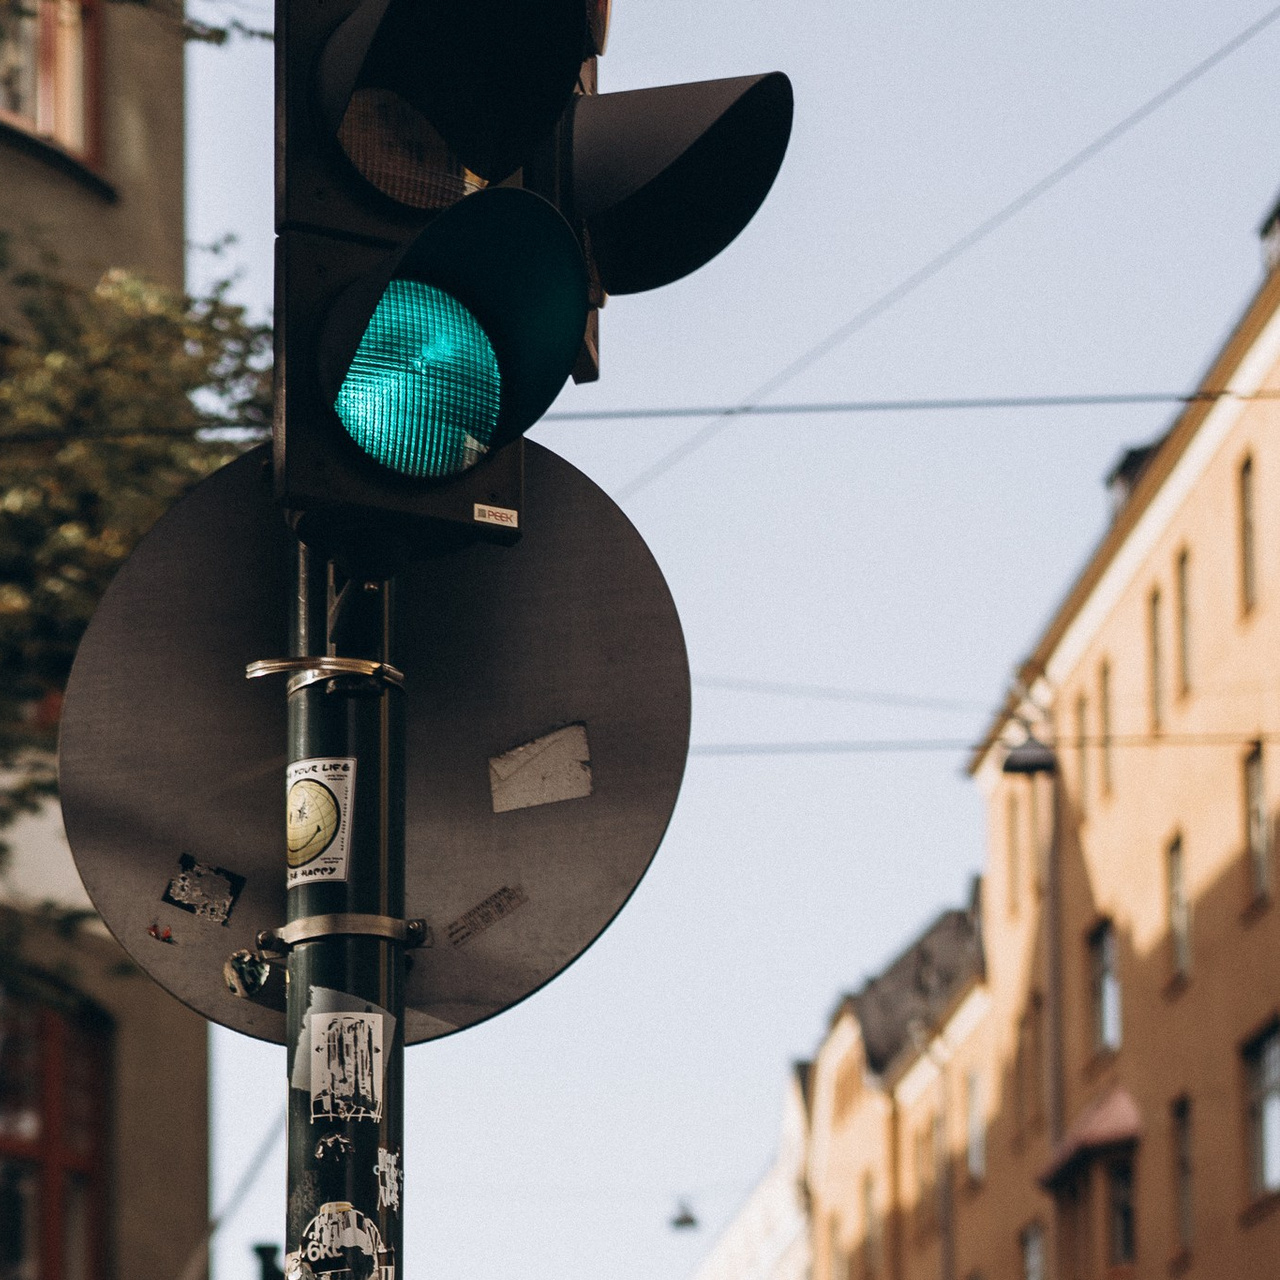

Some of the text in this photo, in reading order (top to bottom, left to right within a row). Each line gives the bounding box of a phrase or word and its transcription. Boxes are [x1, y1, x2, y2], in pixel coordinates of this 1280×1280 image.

[487, 509, 514, 523] PEEK
[294, 763, 350, 777] YOUR LIFE
[300, 866, 336, 877] HAPPY
